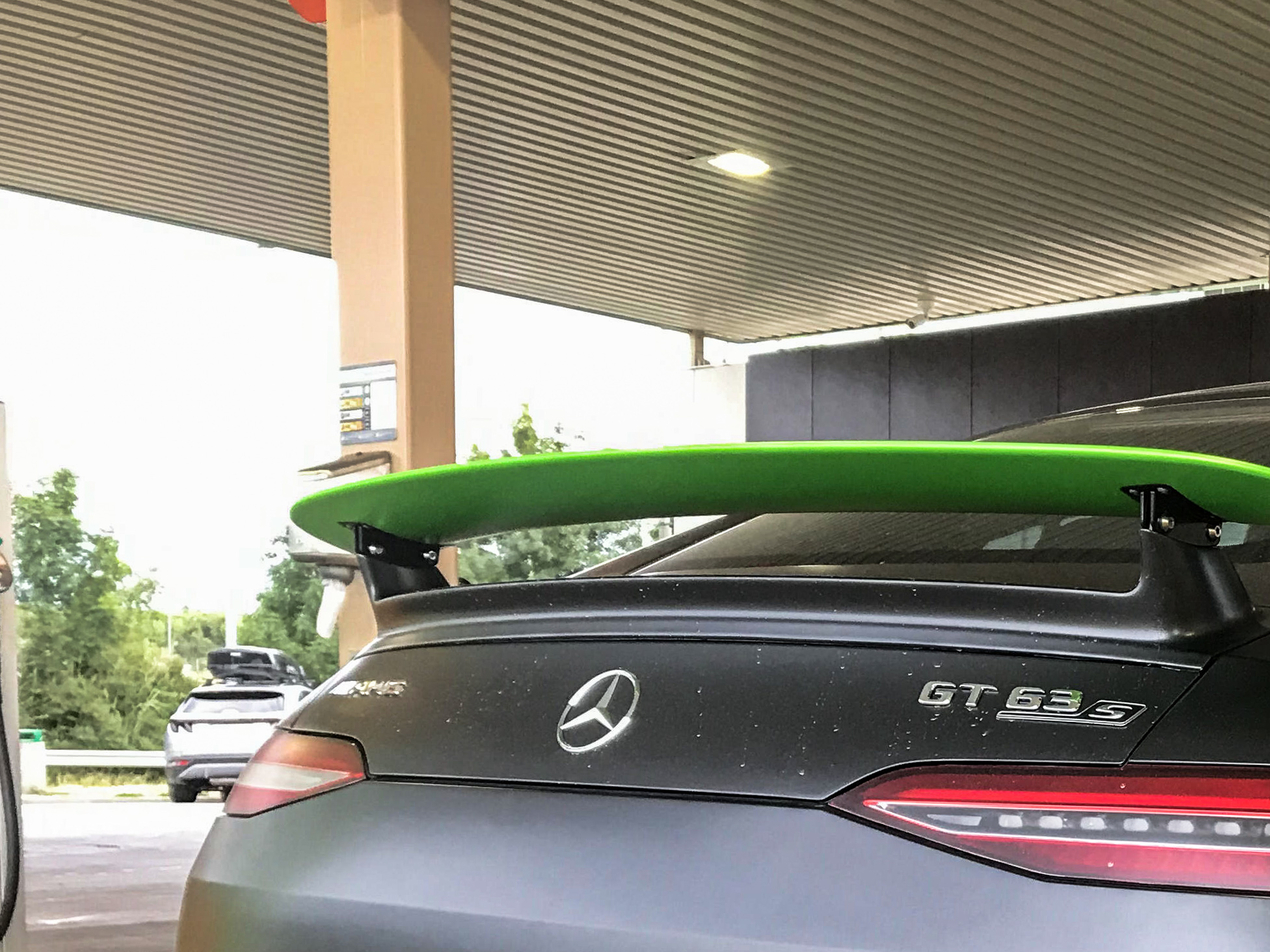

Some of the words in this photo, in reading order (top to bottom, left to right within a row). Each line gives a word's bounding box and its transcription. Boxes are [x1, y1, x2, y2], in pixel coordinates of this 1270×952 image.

[918, 680, 999, 708] GT
[1006, 686, 1083, 713] 63
[1088, 704, 1133, 720] S
